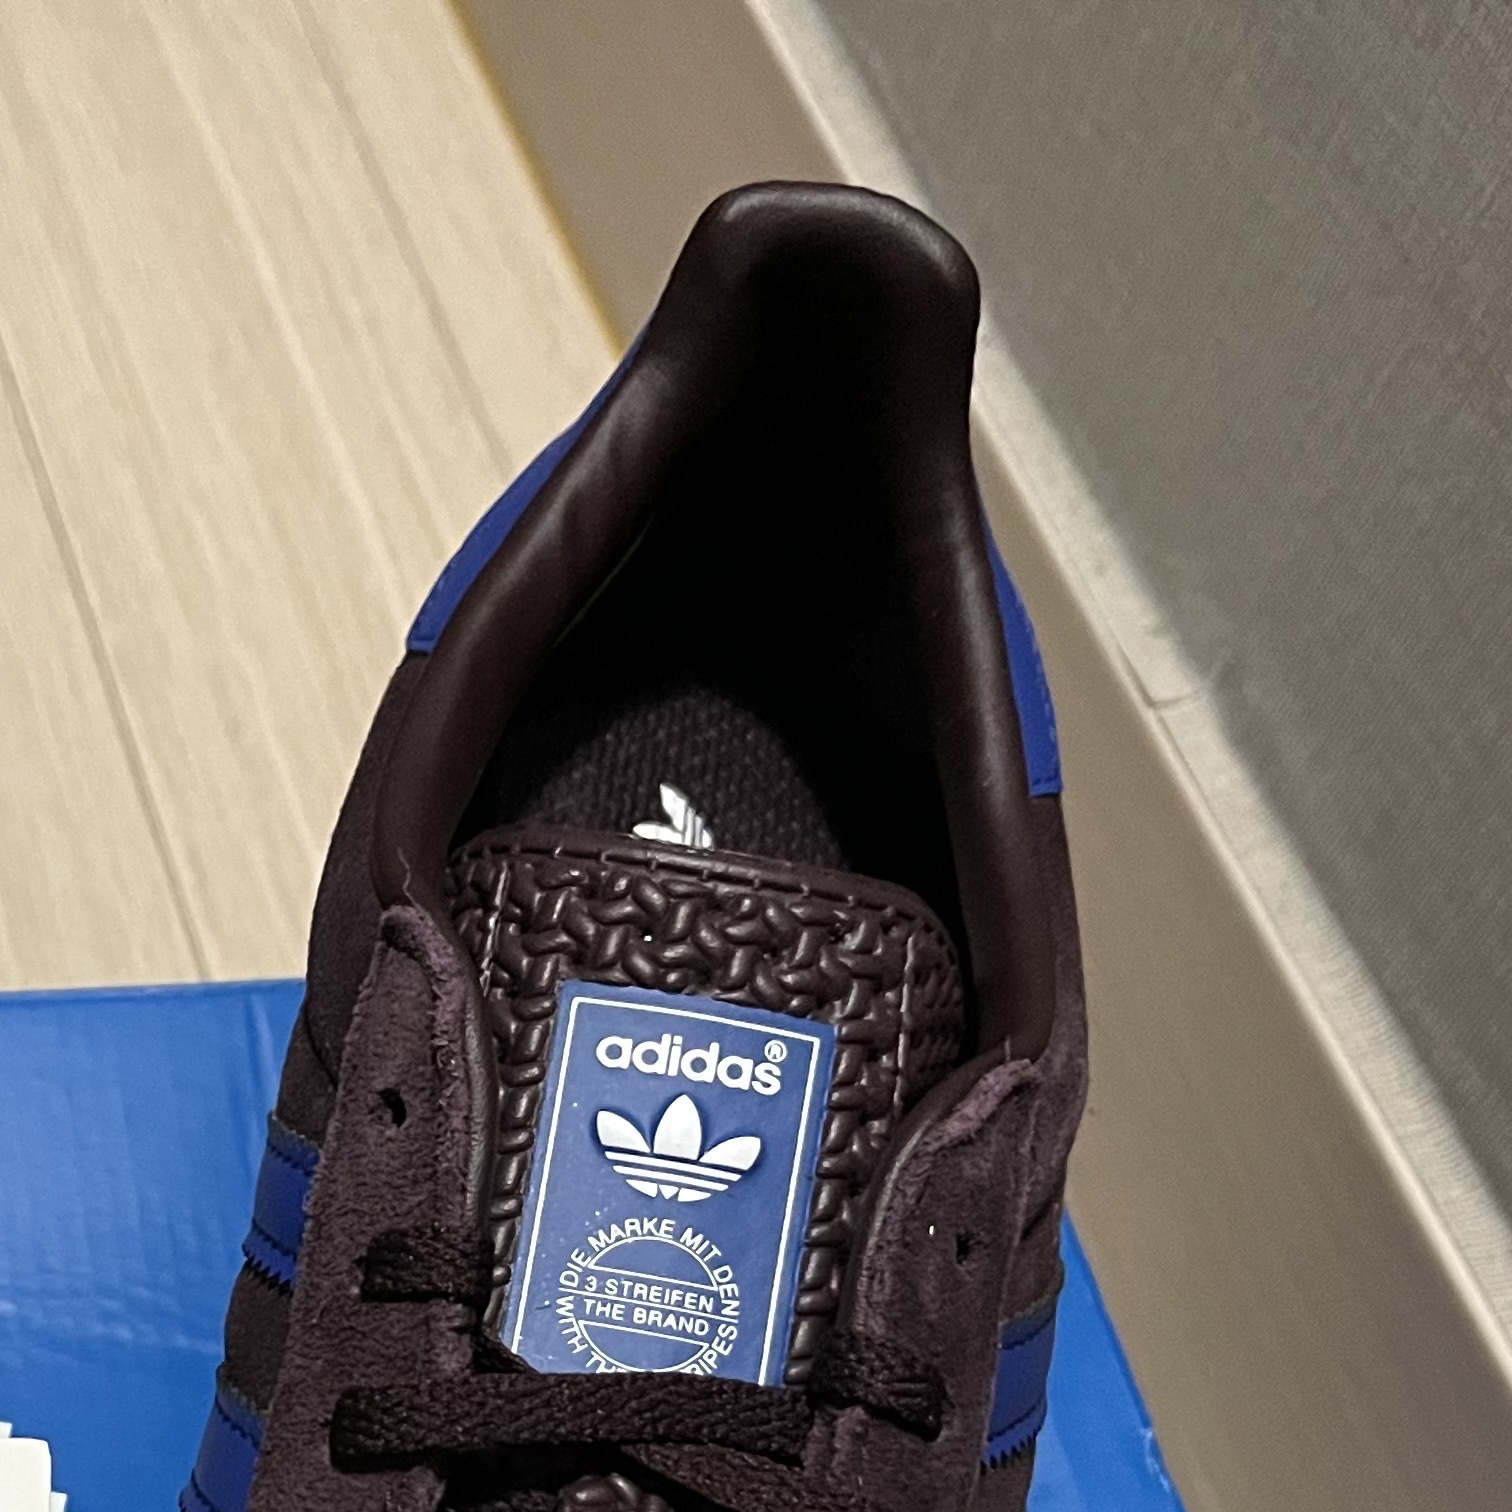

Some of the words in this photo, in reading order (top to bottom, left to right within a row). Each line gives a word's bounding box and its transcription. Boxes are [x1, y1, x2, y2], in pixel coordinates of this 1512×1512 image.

[559, 1247, 592, 1288] DIE
[587, 1217, 676, 1252] MARKE
[679, 1227, 722, 1262] MIT
[713, 1264, 740, 1316] DEN
[583, 1298, 626, 1321] THE
[633, 1307, 709, 1336] BRAND
[584, 1275, 598, 1292] 3
[604, 1278, 714, 1313] STREIFEN
[555, 1295, 589, 1354] WITH
